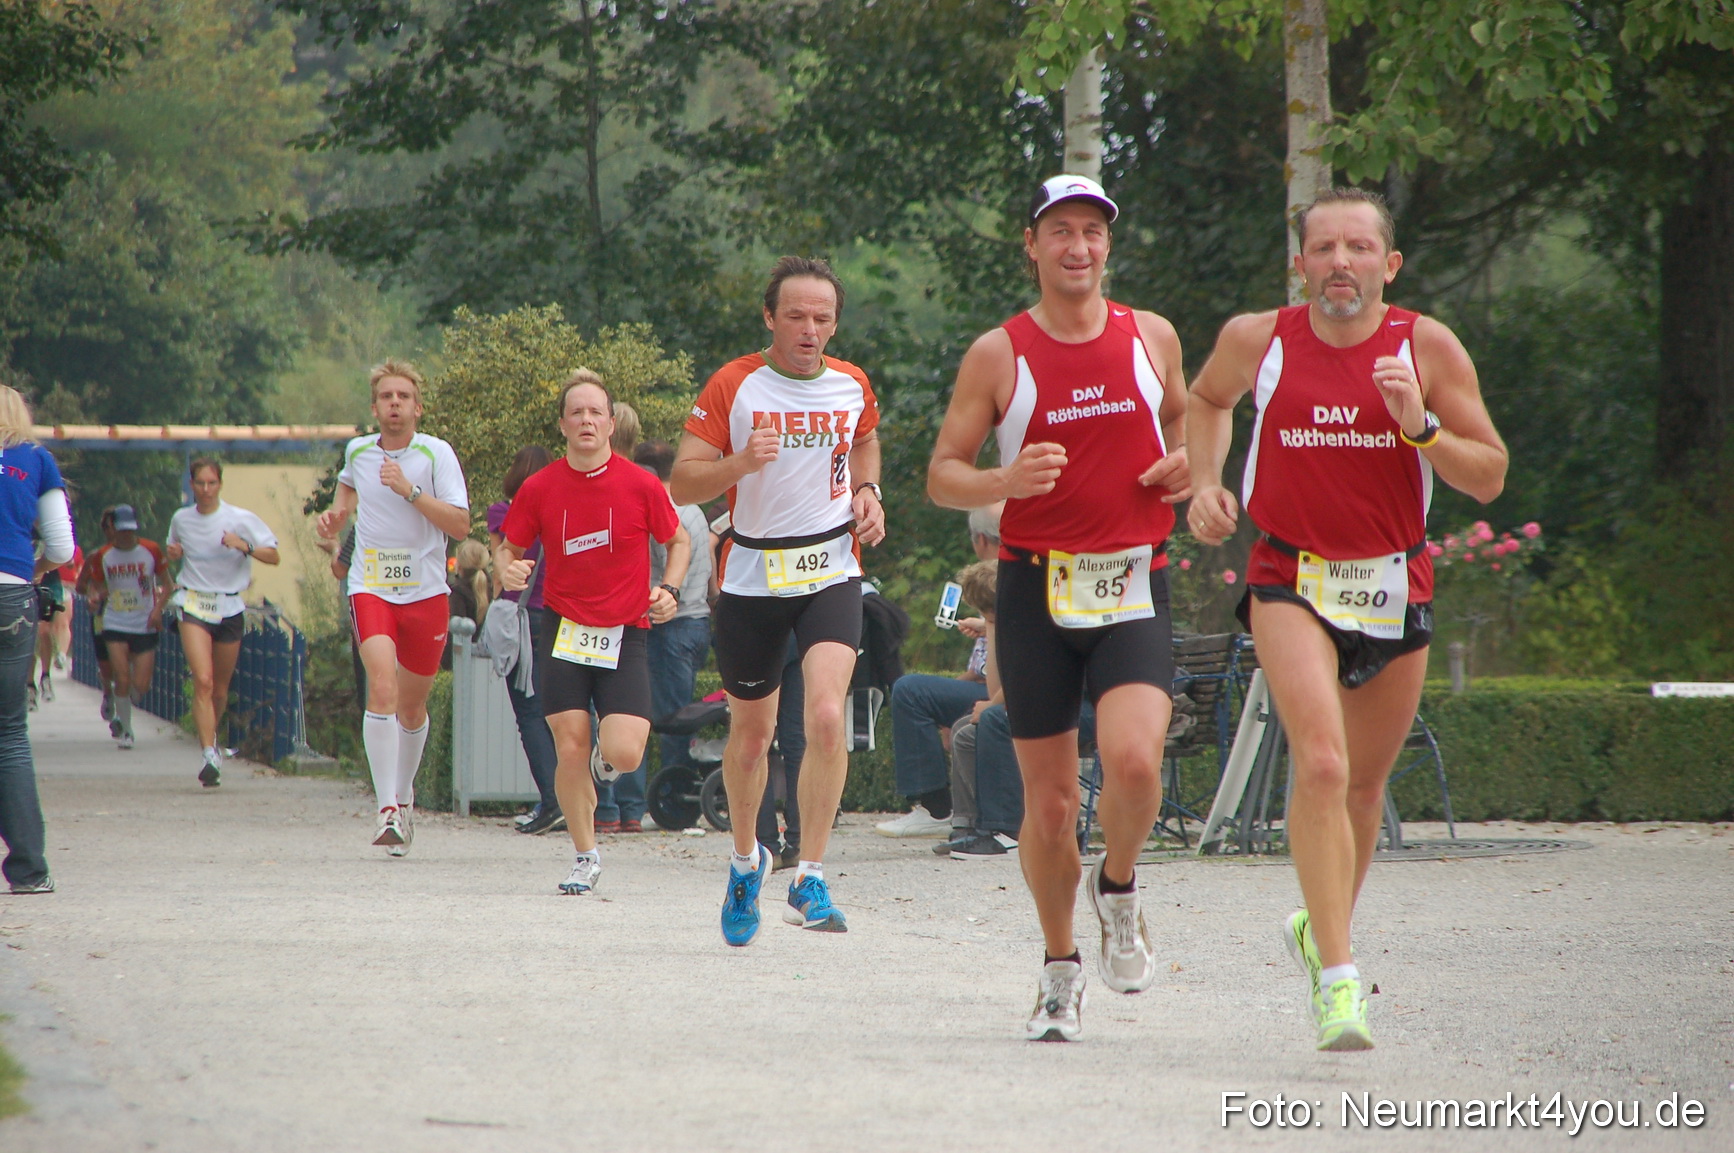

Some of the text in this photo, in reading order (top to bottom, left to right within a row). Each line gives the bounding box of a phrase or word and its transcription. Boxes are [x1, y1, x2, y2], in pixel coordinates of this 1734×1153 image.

[1072, 385, 1105, 402] DAV
[1047, 398, 1136, 424] Röthenbach
[1313, 406, 1359, 424] DAV
[753, 410, 850, 435] MERZ
[768, 428, 834, 449] isen
[1279, 428, 1396, 448] Röthenbach
[7, 466, 28, 480] TV
[378, 552, 412, 561] Christian
[796, 551, 830, 573] 492
[1077, 555, 1142, 572] Alexander
[384, 566, 411, 578] 286
[1329, 562, 1375, 580] Walter
[1095, 575, 1125, 599] 85
[1338, 590, 1389, 608] 530
[580, 632, 610, 651] 319
